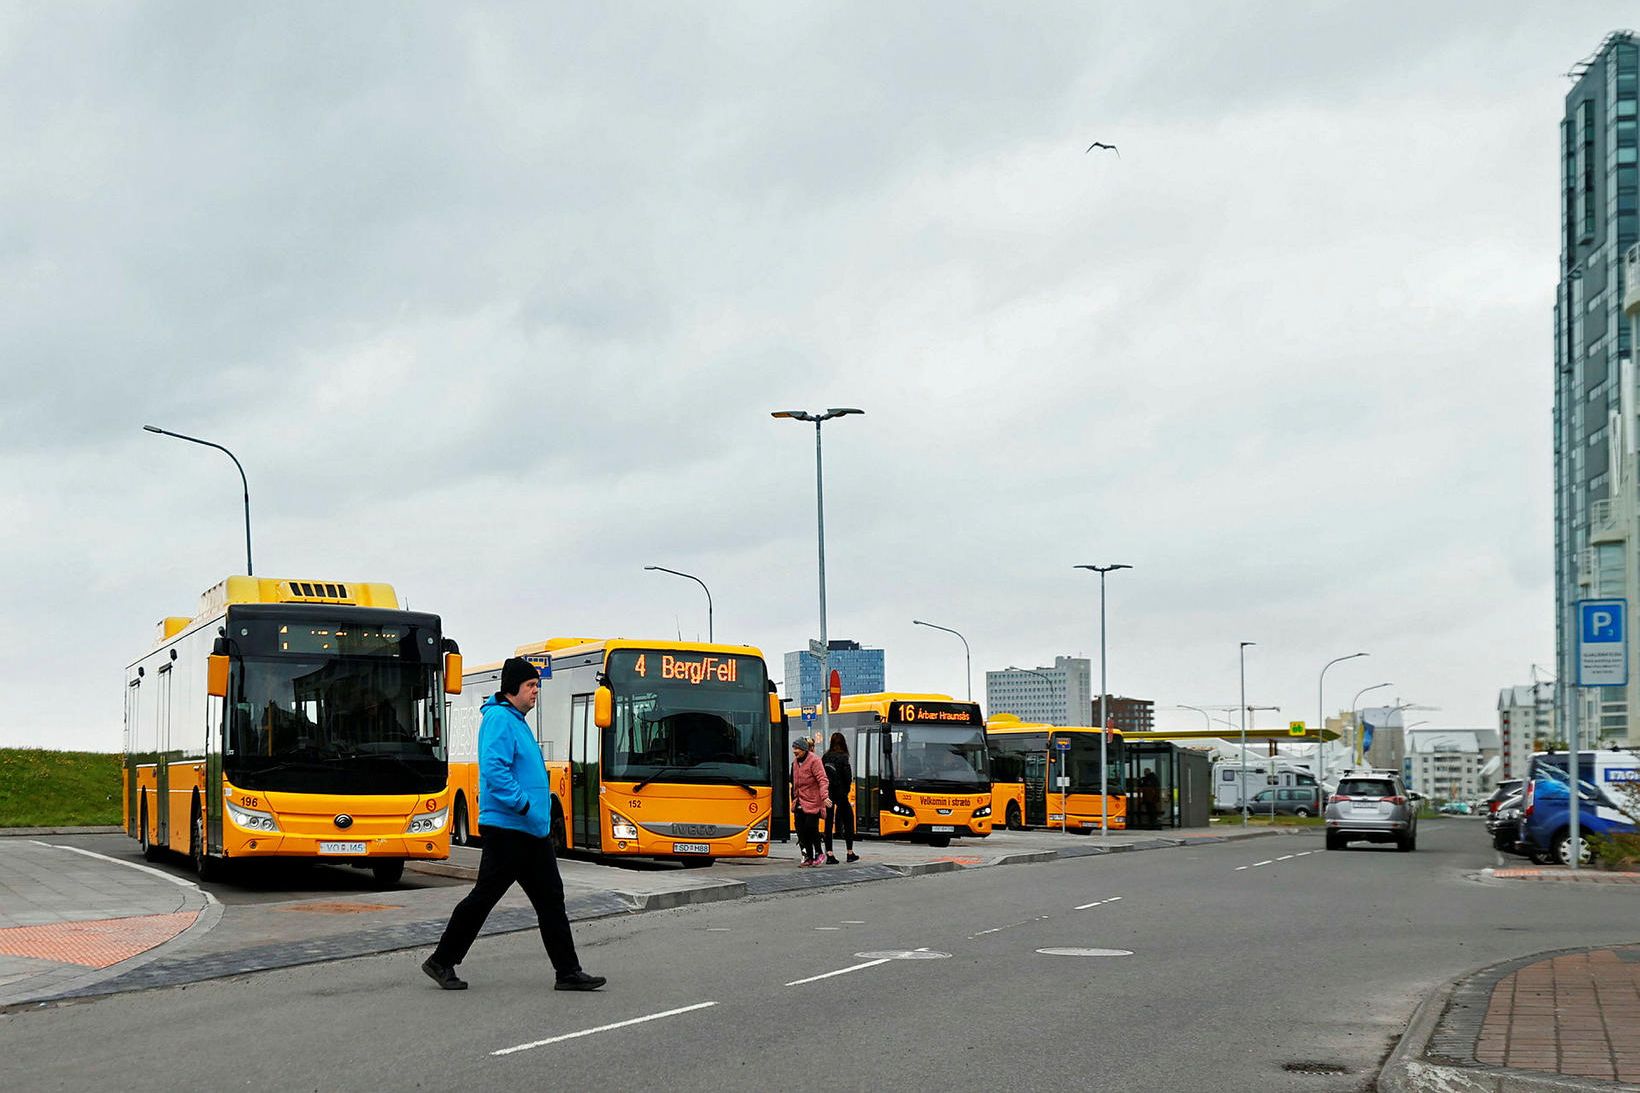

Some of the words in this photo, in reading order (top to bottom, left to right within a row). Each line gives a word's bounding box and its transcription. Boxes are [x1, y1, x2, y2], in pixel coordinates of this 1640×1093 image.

[1593, 612, 1612, 636] P
[634, 653, 647, 678] 4
[661, 654, 737, 684] Berg/Fell
[898, 704, 915, 721] 16
[240, 796, 258, 808] 196
[629, 799, 642, 809] 152
[920, 796, 947, 806] Velkomin
[671, 823, 717, 835] IVECO
